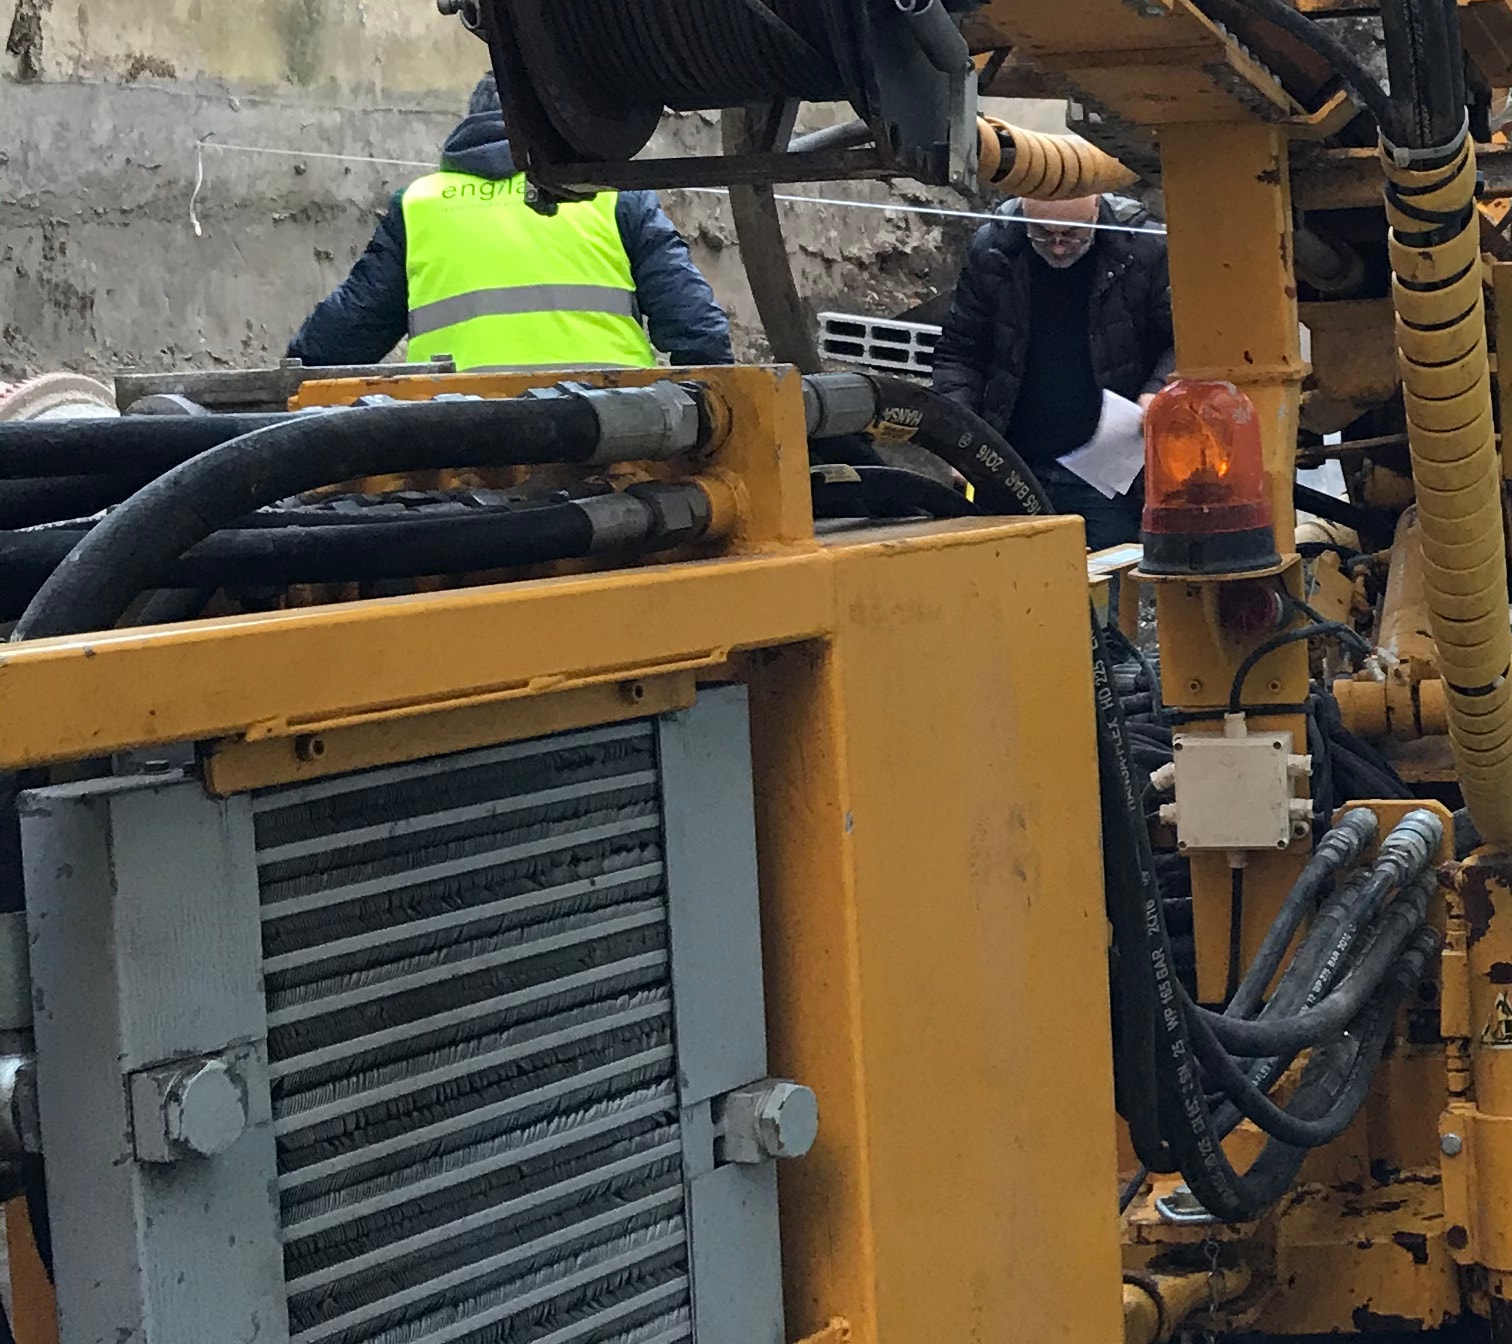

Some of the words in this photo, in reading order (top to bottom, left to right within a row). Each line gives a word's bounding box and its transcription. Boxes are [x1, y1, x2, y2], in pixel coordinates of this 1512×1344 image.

[1001, 470, 1031, 498] BAR
[1091, 658, 1108, 684] 225
[1097, 687, 1114, 709] HD
[1150, 946, 1169, 980] BAR
[1326, 949, 1341, 968] BAR
[1157, 979, 1174, 1004] 165
[1162, 1006, 1179, 1031] WP
[1169, 1038, 1186, 1058] 25
